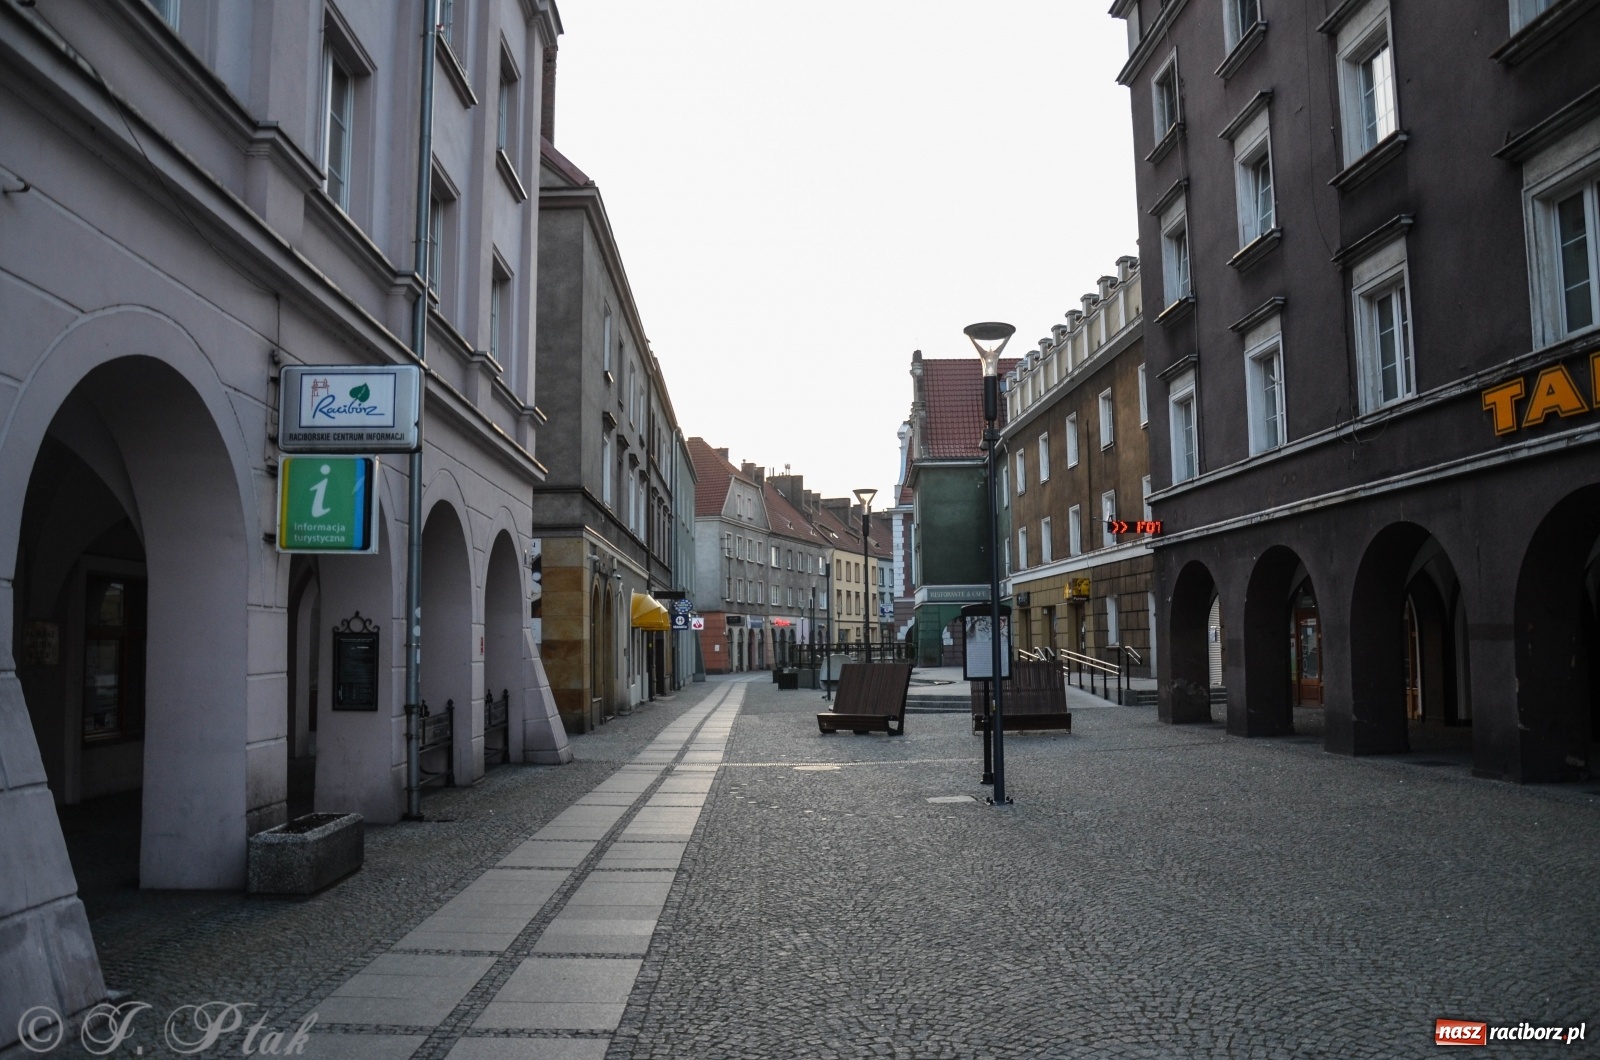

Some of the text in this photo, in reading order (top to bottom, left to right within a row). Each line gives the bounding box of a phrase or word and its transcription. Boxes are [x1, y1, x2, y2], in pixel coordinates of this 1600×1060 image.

[312, 394, 385, 420] Racibórz
[289, 432, 405, 441] RACIBORSKIE CENTRUM INFORMACJI
[294, 521, 346, 534] Informacja
[294, 534, 346, 544] turystyczna
